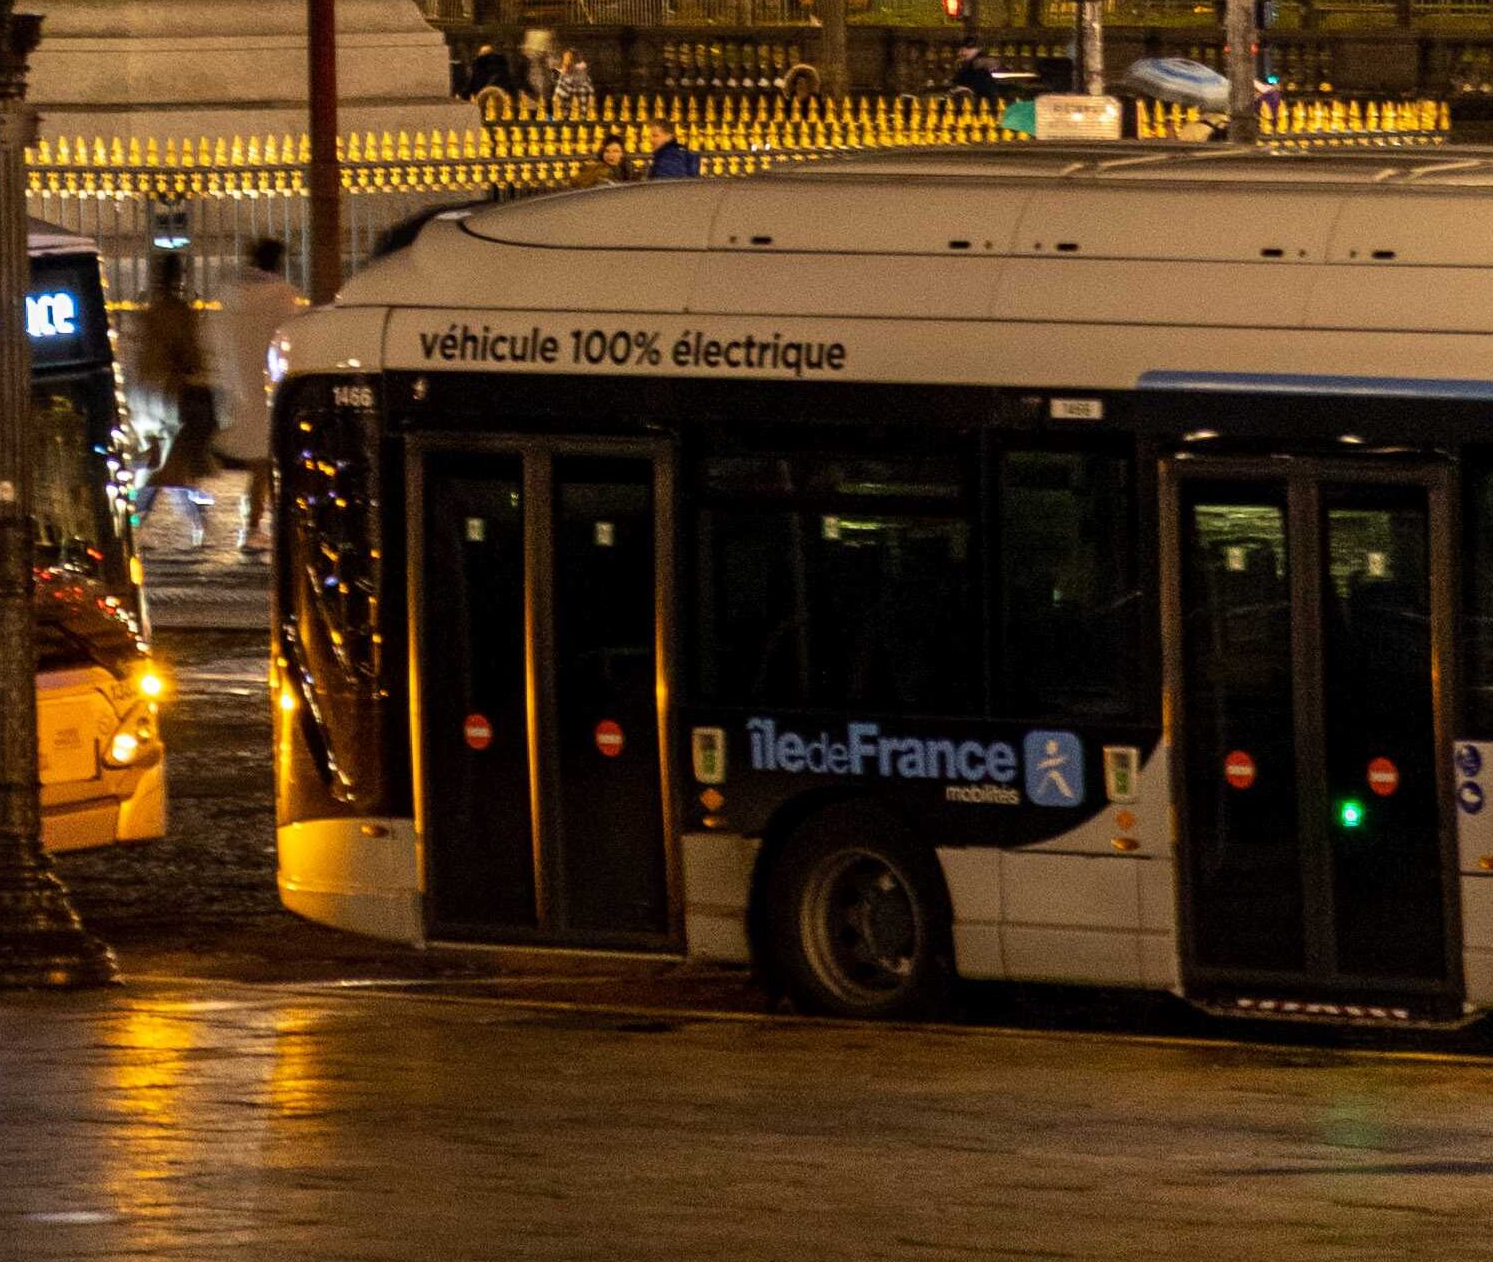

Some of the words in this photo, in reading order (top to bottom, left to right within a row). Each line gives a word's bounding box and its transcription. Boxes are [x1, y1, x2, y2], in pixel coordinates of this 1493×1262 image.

[419, 324, 560, 364] véhicule
[570, 328, 661, 367] 100%
[671, 330, 847, 377] électrique
